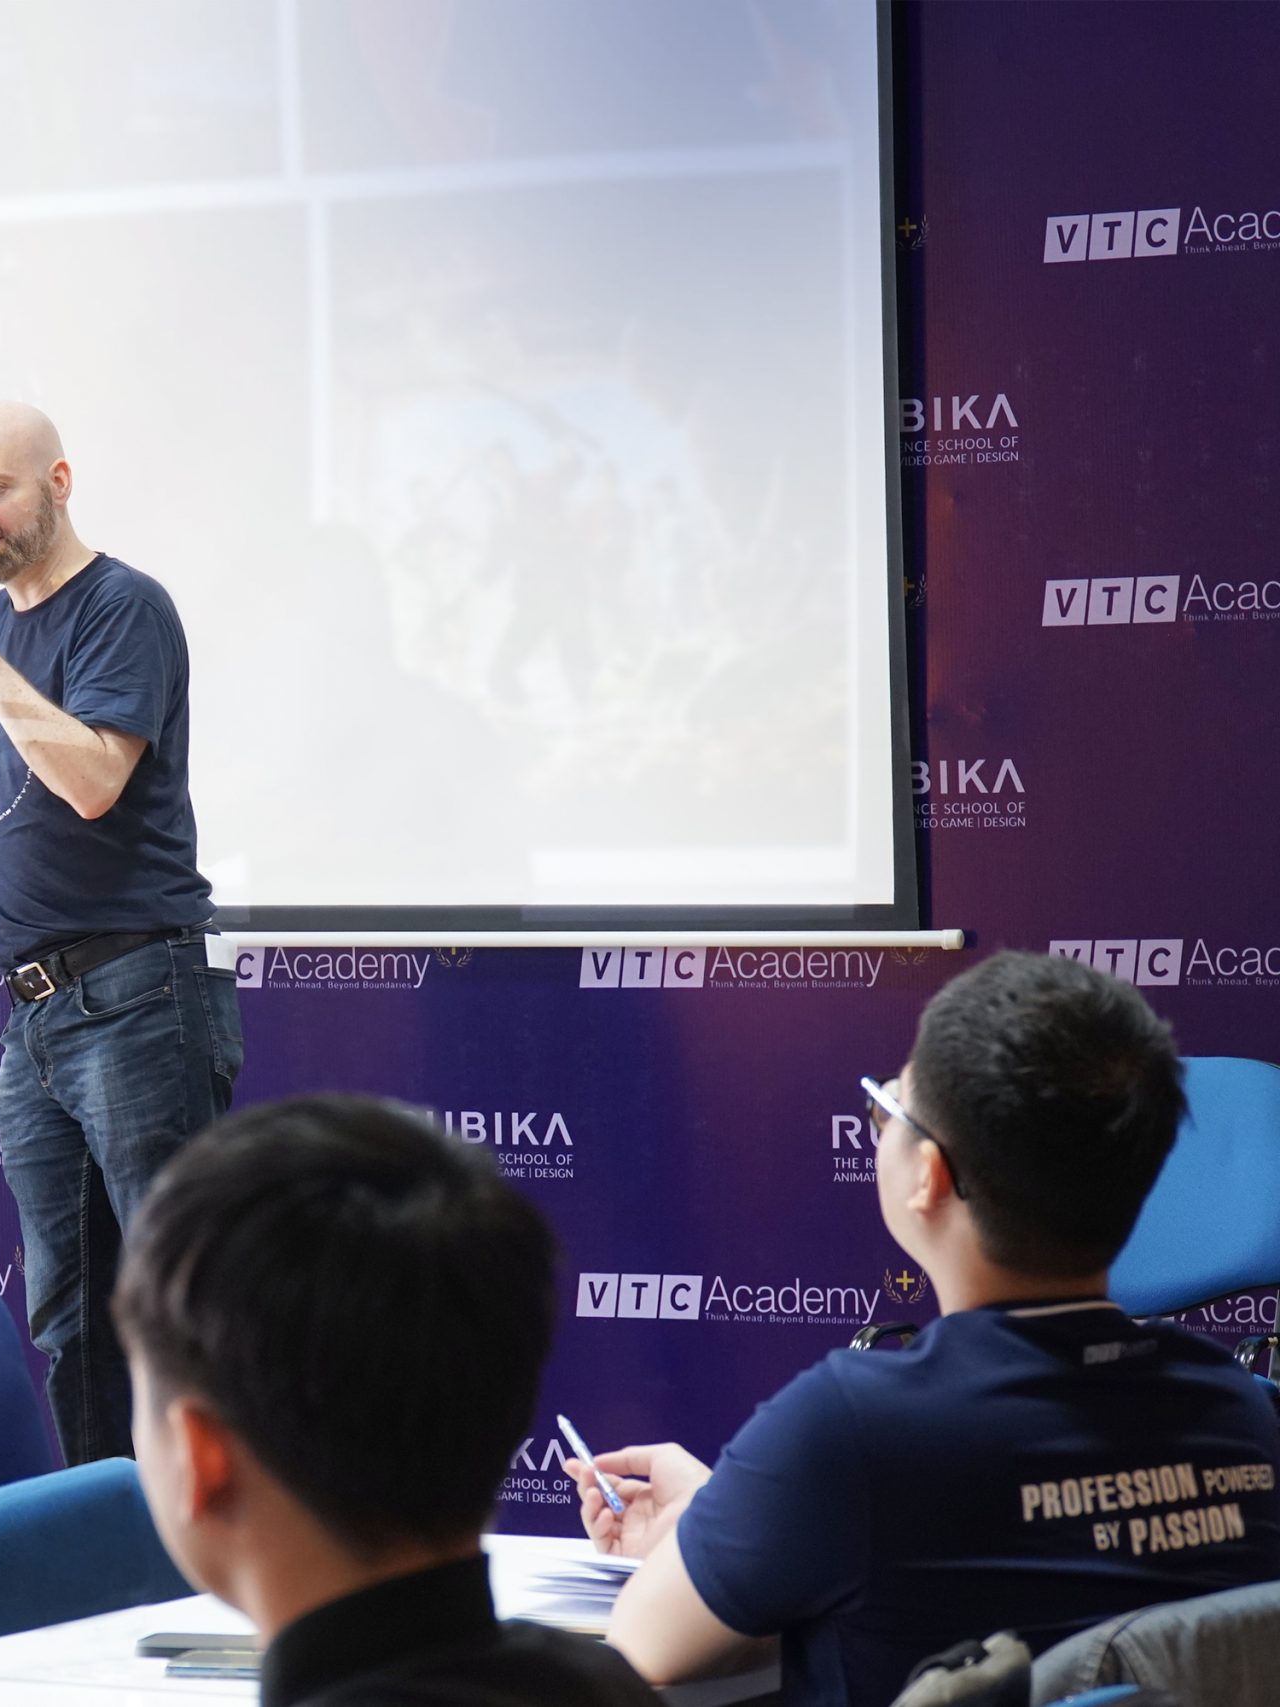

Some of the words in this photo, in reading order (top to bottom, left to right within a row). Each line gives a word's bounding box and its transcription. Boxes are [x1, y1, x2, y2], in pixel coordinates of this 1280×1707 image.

[1054, 215, 1171, 256] VTC
[900, 393, 1019, 432] BIKA
[937, 437, 994, 452] SCHOOL
[1000, 435, 1019, 449] OF
[934, 453, 967, 465] GAME
[976, 450, 1019, 463] DESIGN
[1053, 581, 1170, 620] VTC
[911, 758, 1026, 795] BIKA
[944, 802, 1001, 815] SCHOOL
[1006, 801, 1026, 814] OF
[940, 817, 975, 828] GAME
[983, 816, 1026, 828] DESIGN
[268, 946, 431, 989] Academy
[589, 948, 698, 983] VTC
[709, 946, 884, 988] Academy
[328, 981, 360, 991] Beyond
[362, 981, 412, 989] Boundaries
[710, 980, 735, 988] Think
[774, 980, 811, 990] Beyond
[812, 980, 865, 989] Boundaries
[498, 1152, 551, 1166] SCHOOL
[556, 1153, 574, 1166] OF
[833, 1157, 860, 1169] THE
[534, 1167, 574, 1179] DESIGN
[833, 1172, 877, 1183] ANIMAT
[586, 1278, 693, 1313] VTC
[705, 1275, 881, 1325] Academy
[705, 1312, 730, 1321] Think
[769, 1314, 804, 1325] Beyond
[807, 1315, 861, 1325] Boundaries
[500, 1477, 548, 1491] CHOOL
[553, 1479, 571, 1492] OF
[1021, 1462, 1199, 1522] PROFESSION
[1201, 1463, 1275, 1497] POWERED
[532, 1492, 572, 1505] DESIGN
[1092, 1520, 1121, 1551] BY
[1128, 1502, 1246, 1556] PASSION
